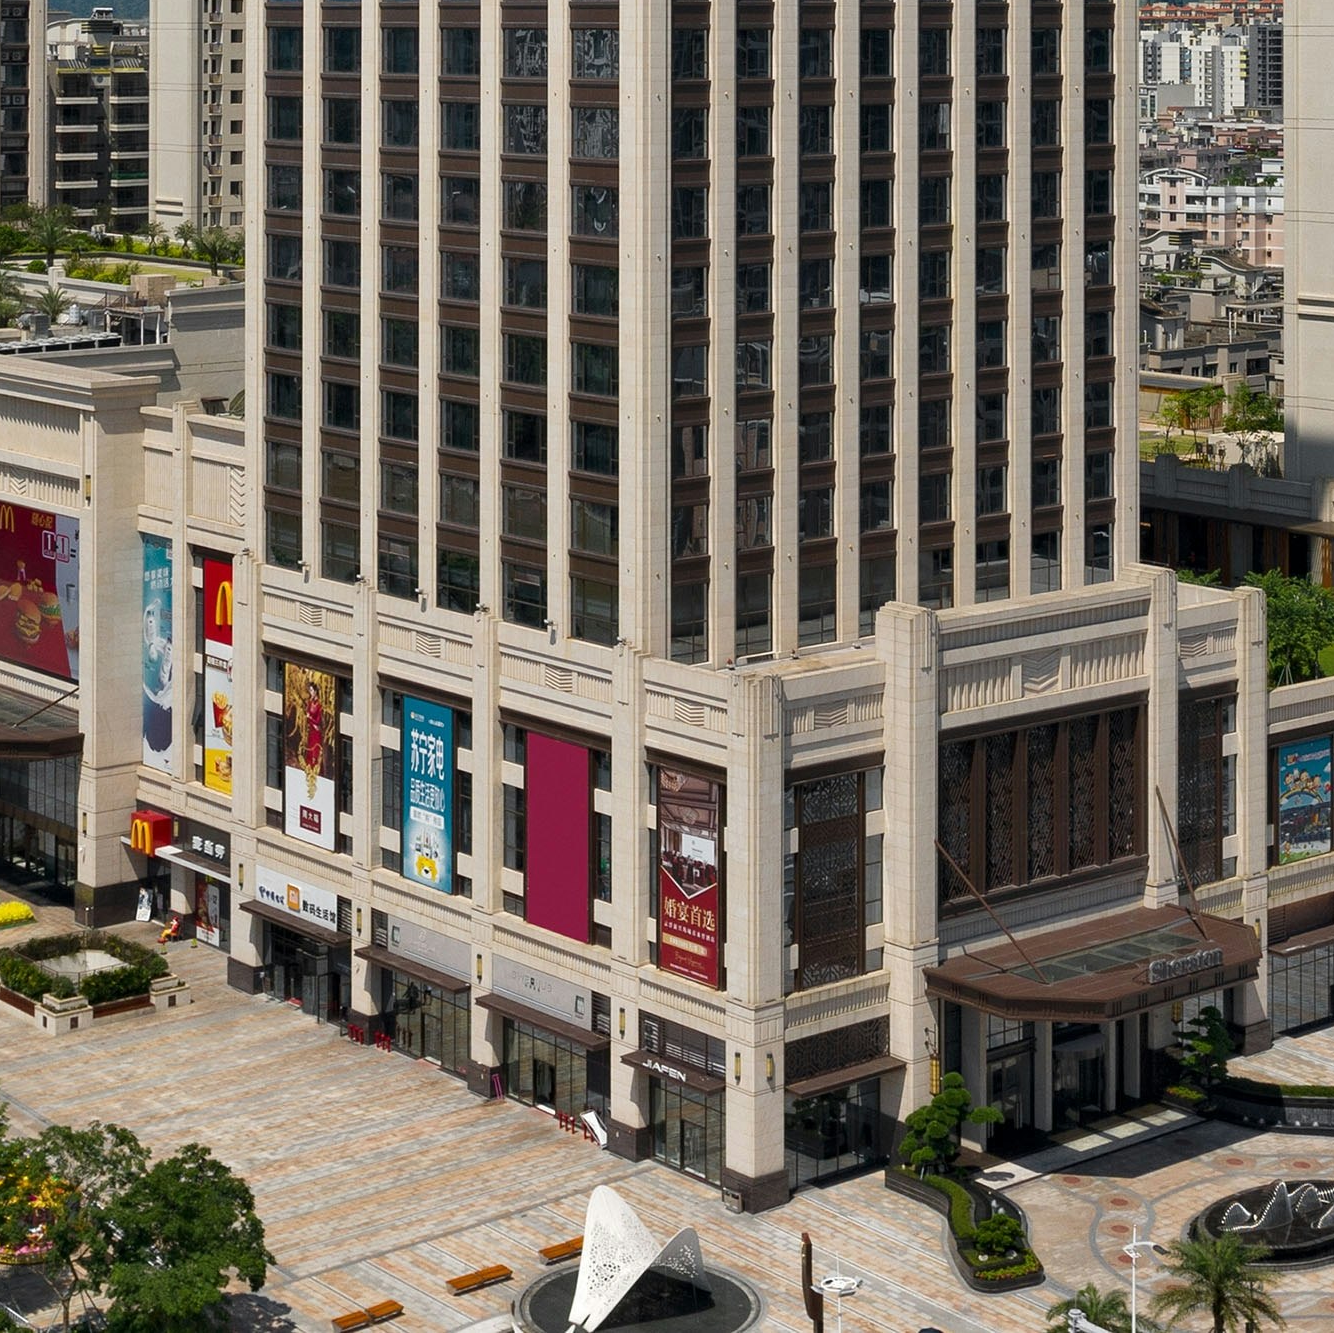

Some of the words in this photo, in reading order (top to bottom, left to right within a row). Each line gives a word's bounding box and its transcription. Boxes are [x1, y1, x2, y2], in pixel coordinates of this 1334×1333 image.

[410, 728, 445, 781] 苏宁家电
[192, 835, 225, 860] 麦当劳
[302, 900, 336, 924] 数码生活馆
[664, 896, 716, 932] 婚宴首选
[1149, 948, 1223, 984] Sheraton
[642, 1059, 686, 1082] JIAFEN
